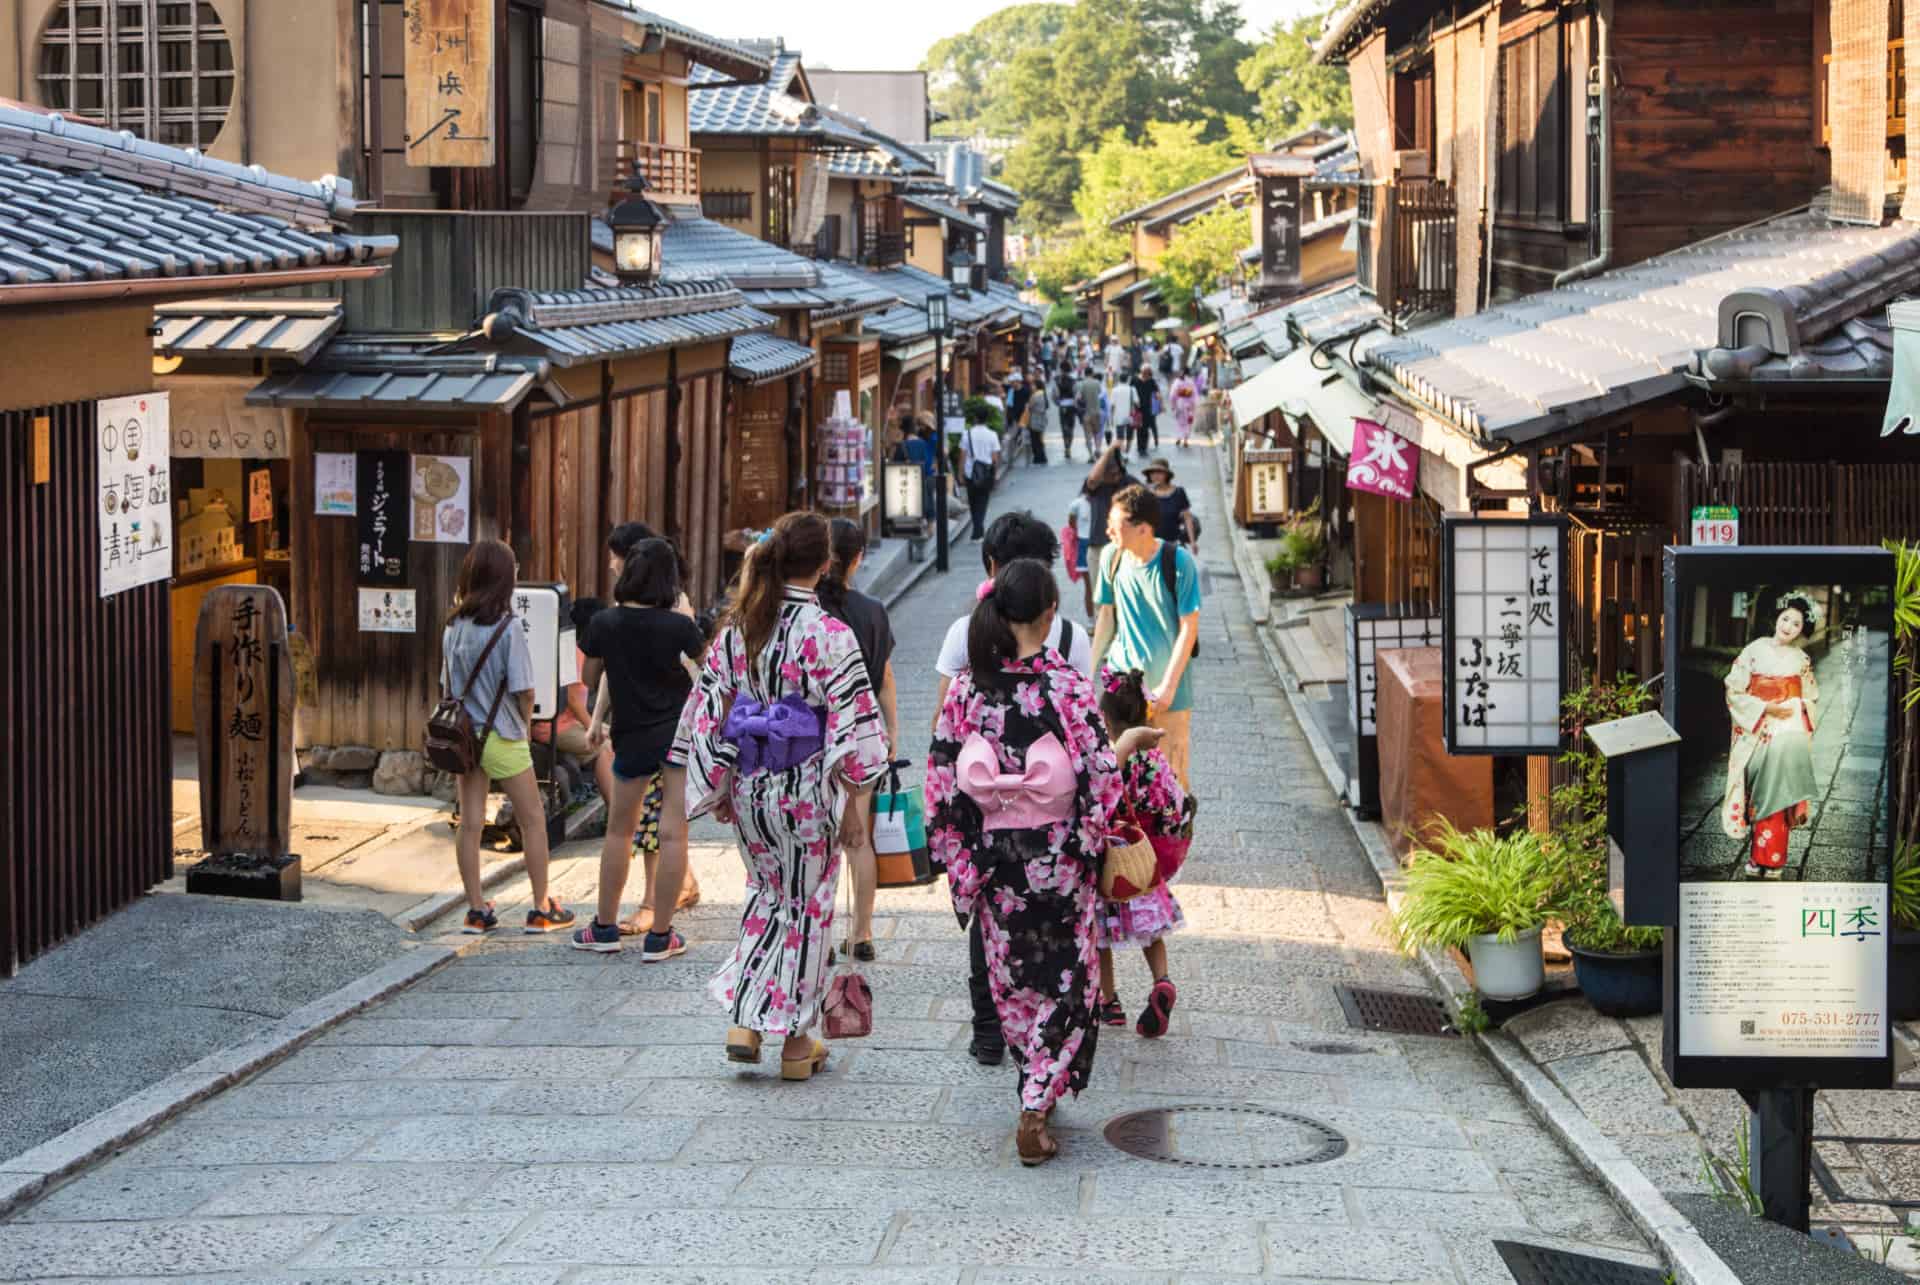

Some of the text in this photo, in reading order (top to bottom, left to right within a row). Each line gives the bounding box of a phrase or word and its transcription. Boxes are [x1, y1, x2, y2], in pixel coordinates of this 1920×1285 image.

[1366, 430, 1410, 471] 氷
[370, 491, 391, 568] ジェラート
[1696, 523, 1734, 543] 119
[1530, 546, 1555, 627] そば処
[229, 595, 264, 742] 手作り麺
[1497, 597, 1525, 679] 二寧坂
[1460, 638, 1496, 729] ふたば
[1802, 904, 1882, 942] 四季
[1781, 1012, 1880, 1026] 075-531-2777
